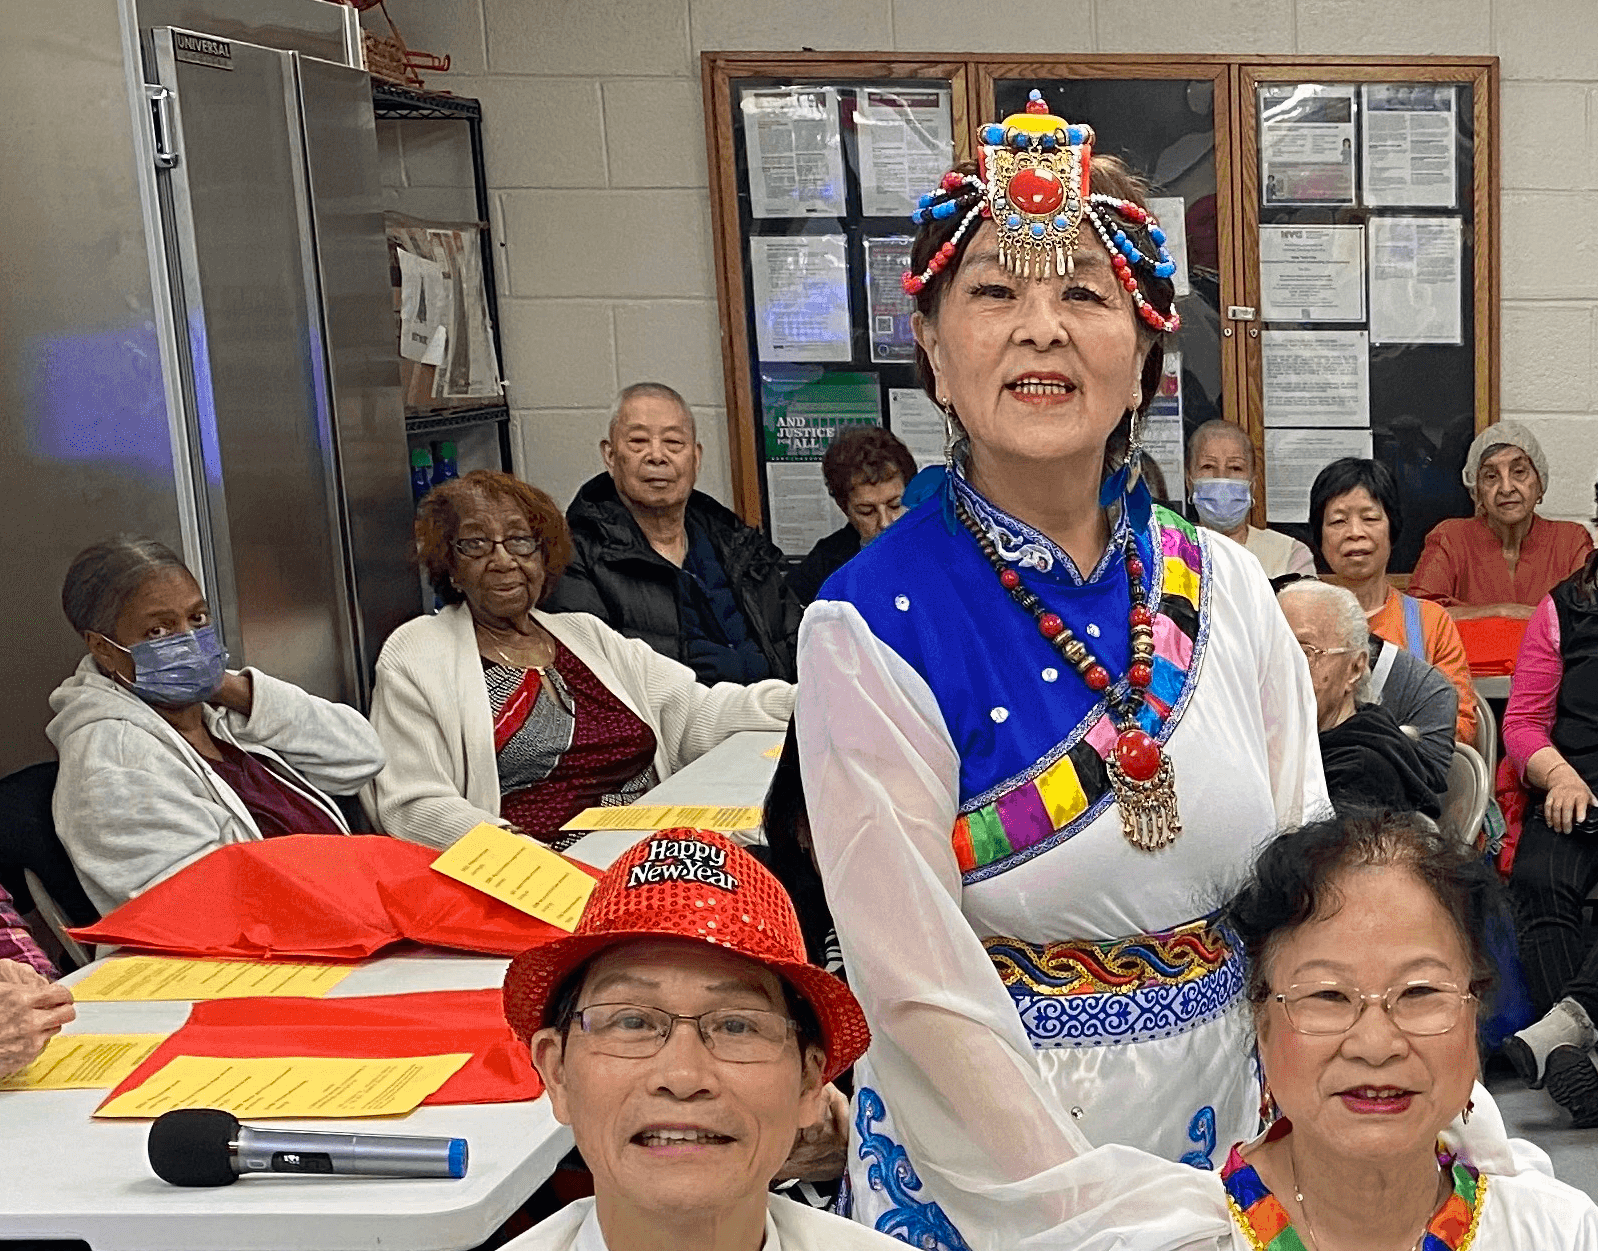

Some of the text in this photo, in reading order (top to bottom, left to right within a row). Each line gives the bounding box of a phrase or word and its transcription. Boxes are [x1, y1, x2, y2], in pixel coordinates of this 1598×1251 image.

[177, 35, 230, 57] UNIVERSAL
[776, 416, 806, 428] AND
[776, 427, 836, 438] JUSTICE
[793, 438, 820, 449] ALL
[648, 839, 727, 867] Happy
